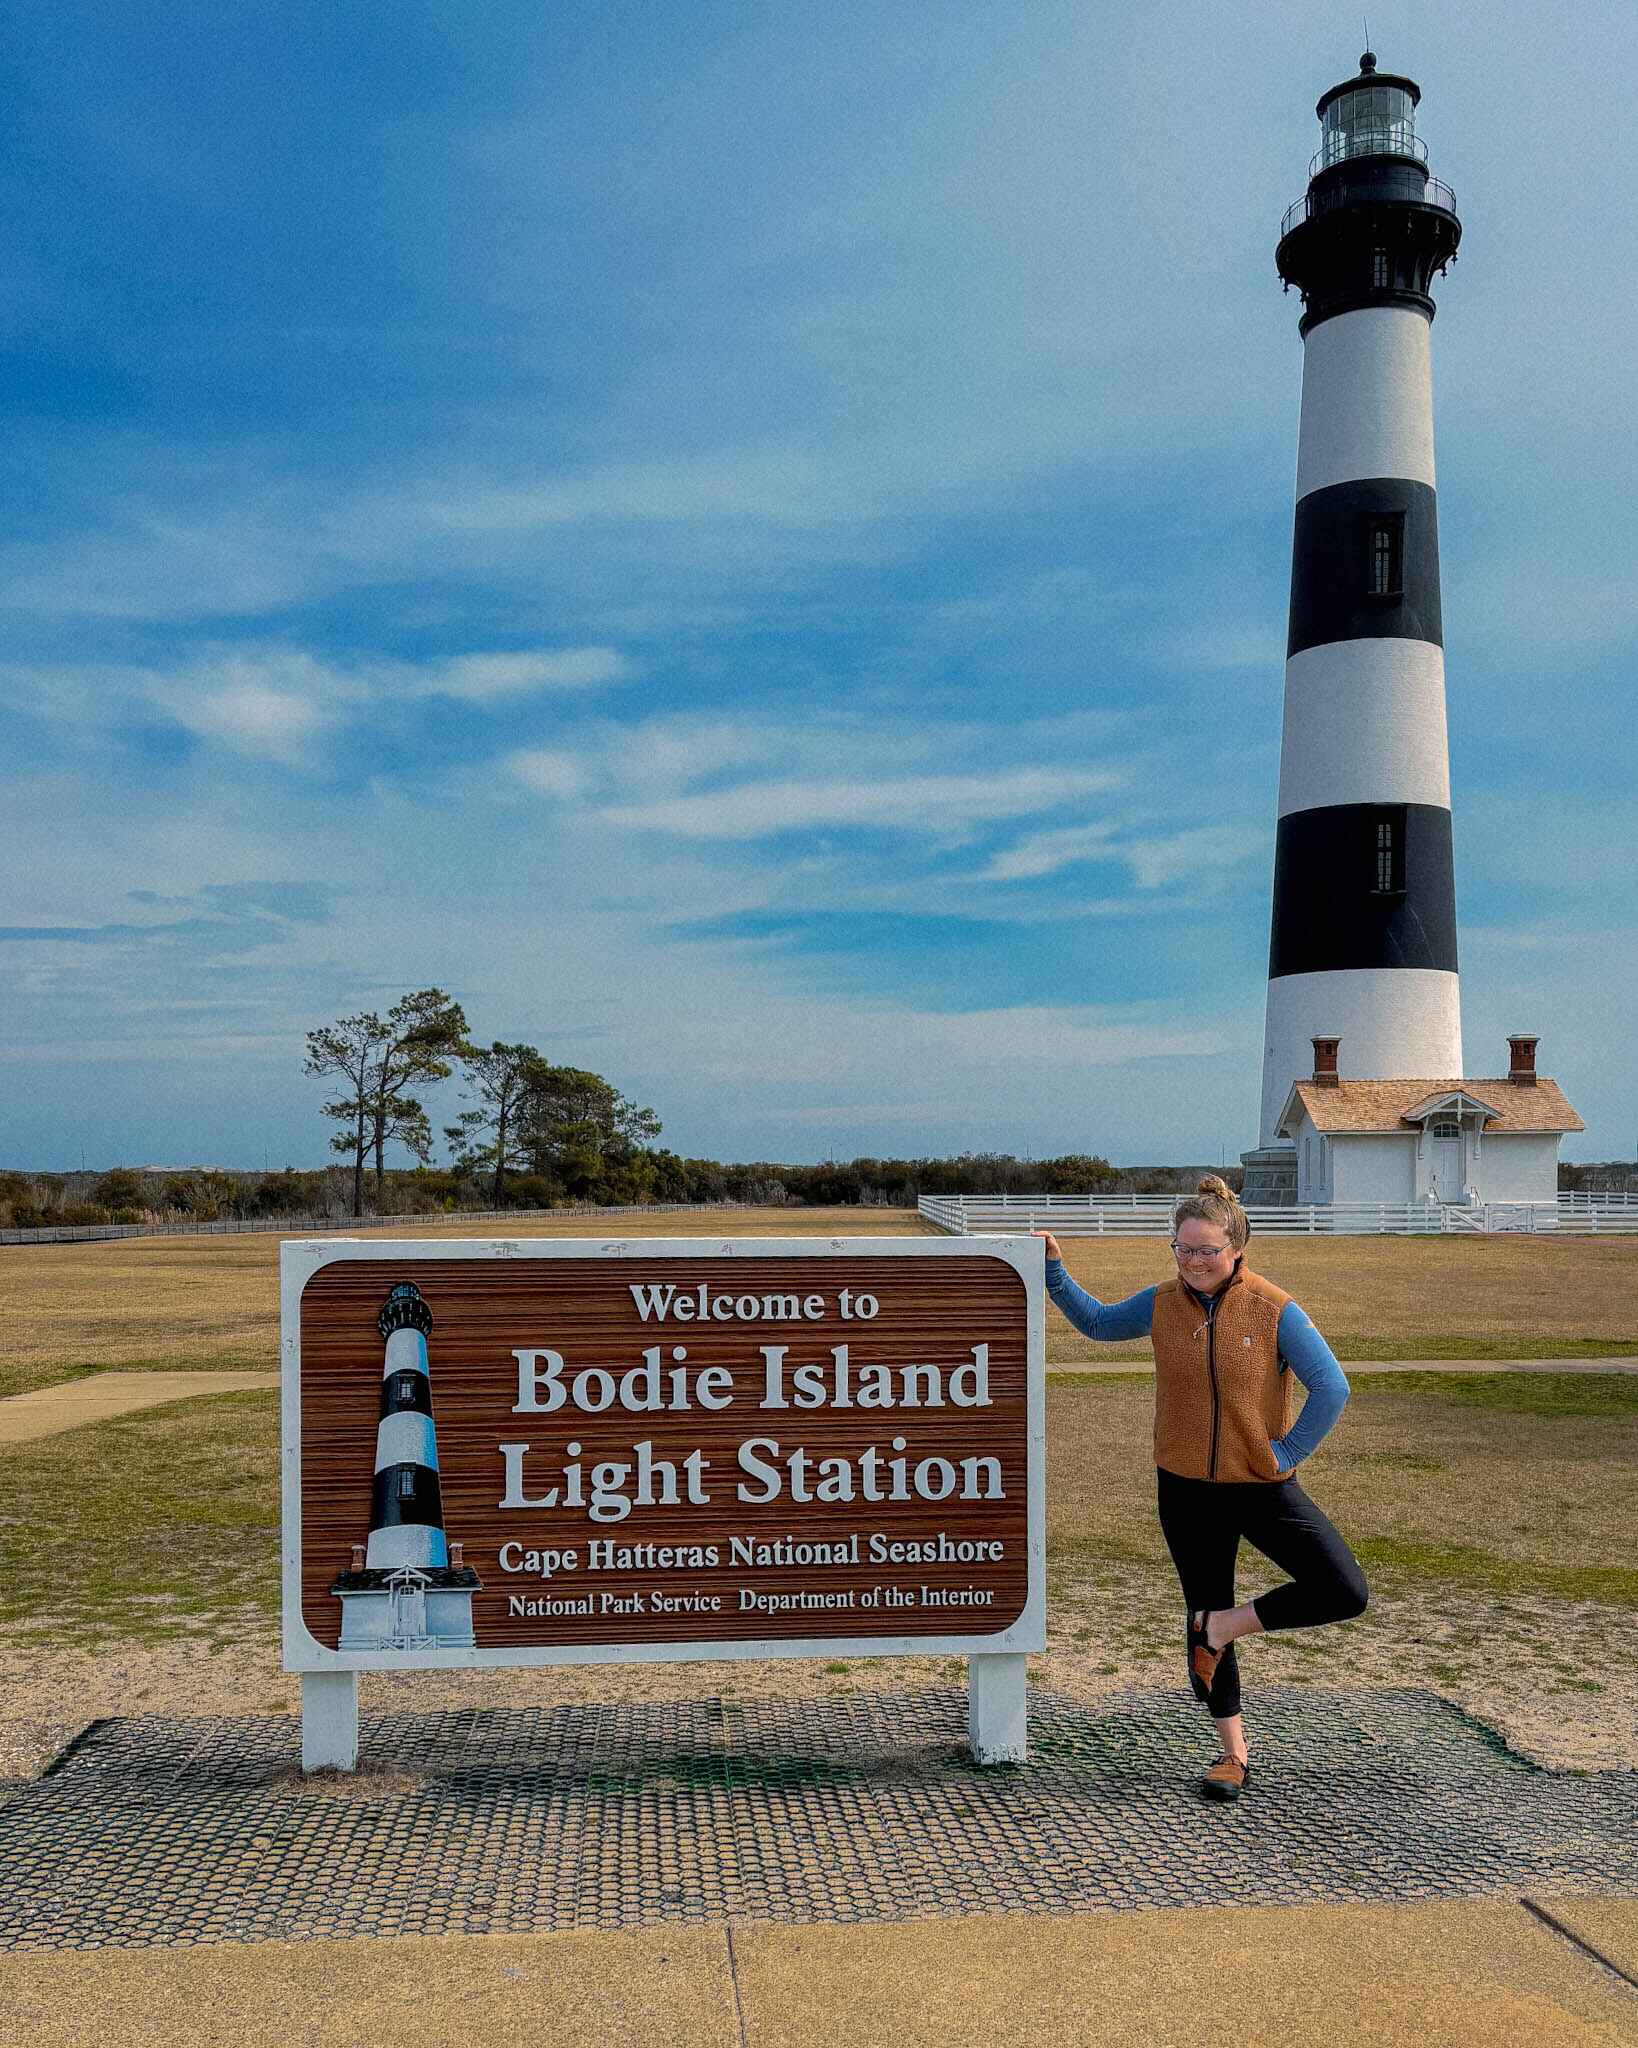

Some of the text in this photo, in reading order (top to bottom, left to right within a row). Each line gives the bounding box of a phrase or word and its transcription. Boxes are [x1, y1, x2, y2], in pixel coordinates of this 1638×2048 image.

[629, 1283, 880, 1322] Welcome to
[511, 1342, 994, 1413] Bodie Island
[498, 1436, 1007, 1523] Light Station
[499, 1532, 1004, 1579] Cape Hatteras National Seashore
[508, 1585, 994, 1617] National Park Service Department of the Interior
